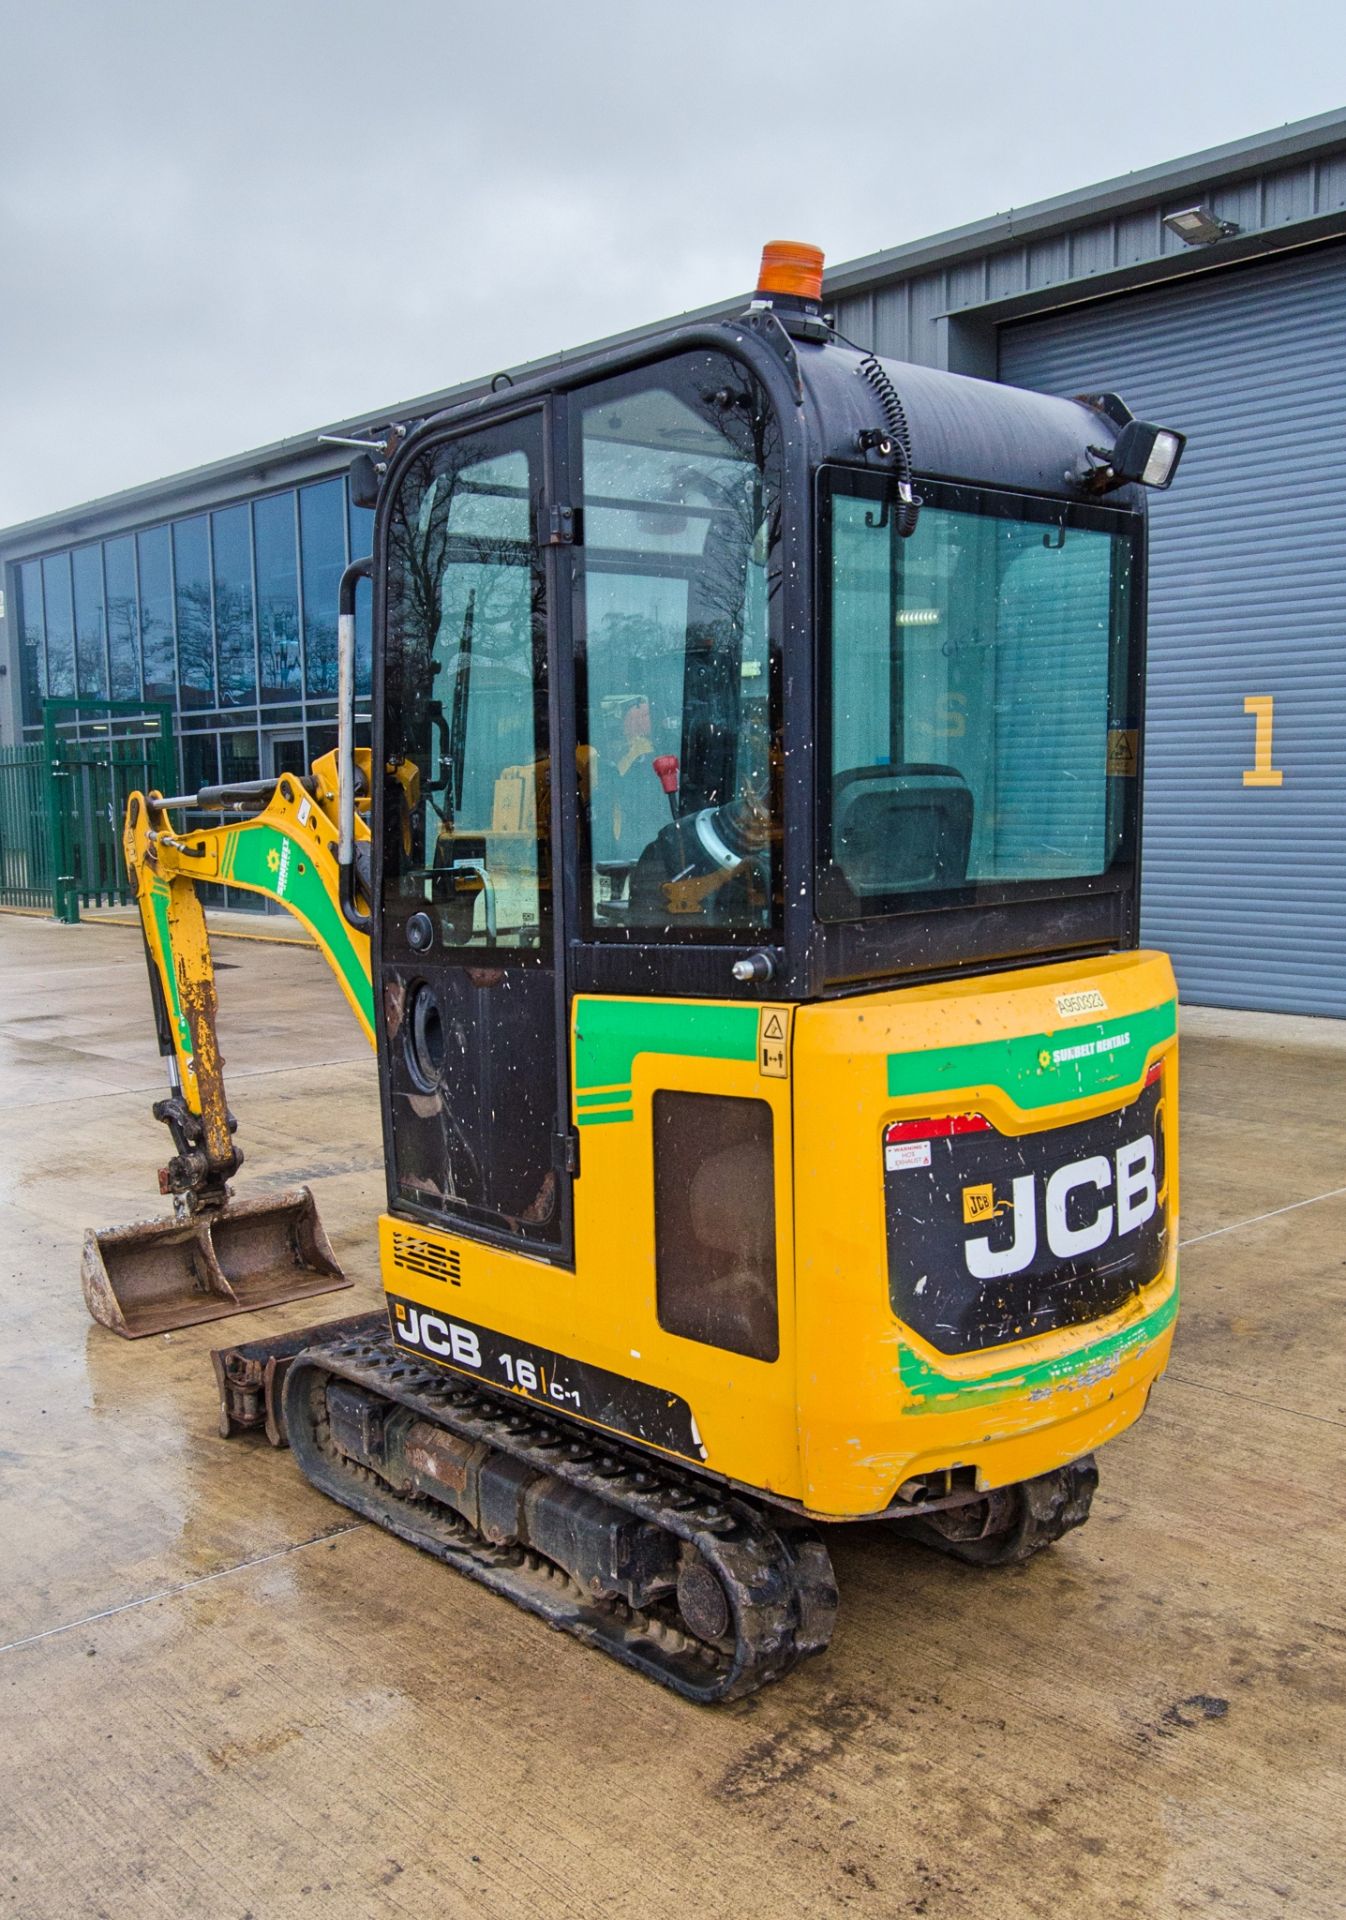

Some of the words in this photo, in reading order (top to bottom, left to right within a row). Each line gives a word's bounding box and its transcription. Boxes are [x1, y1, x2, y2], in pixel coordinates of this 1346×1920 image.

[1243, 696, 1283, 786] 1
[1057, 993, 1104, 1013] A950323
[1053, 1042, 1095, 1063] SUNBELT
[1096, 1032, 1131, 1053] RENTALS
[965, 1135, 1156, 1279] JCB
[970, 1194, 990, 1214] JCB
[397, 1308, 482, 1368] JCB
[498, 1353, 538, 1390] 16
